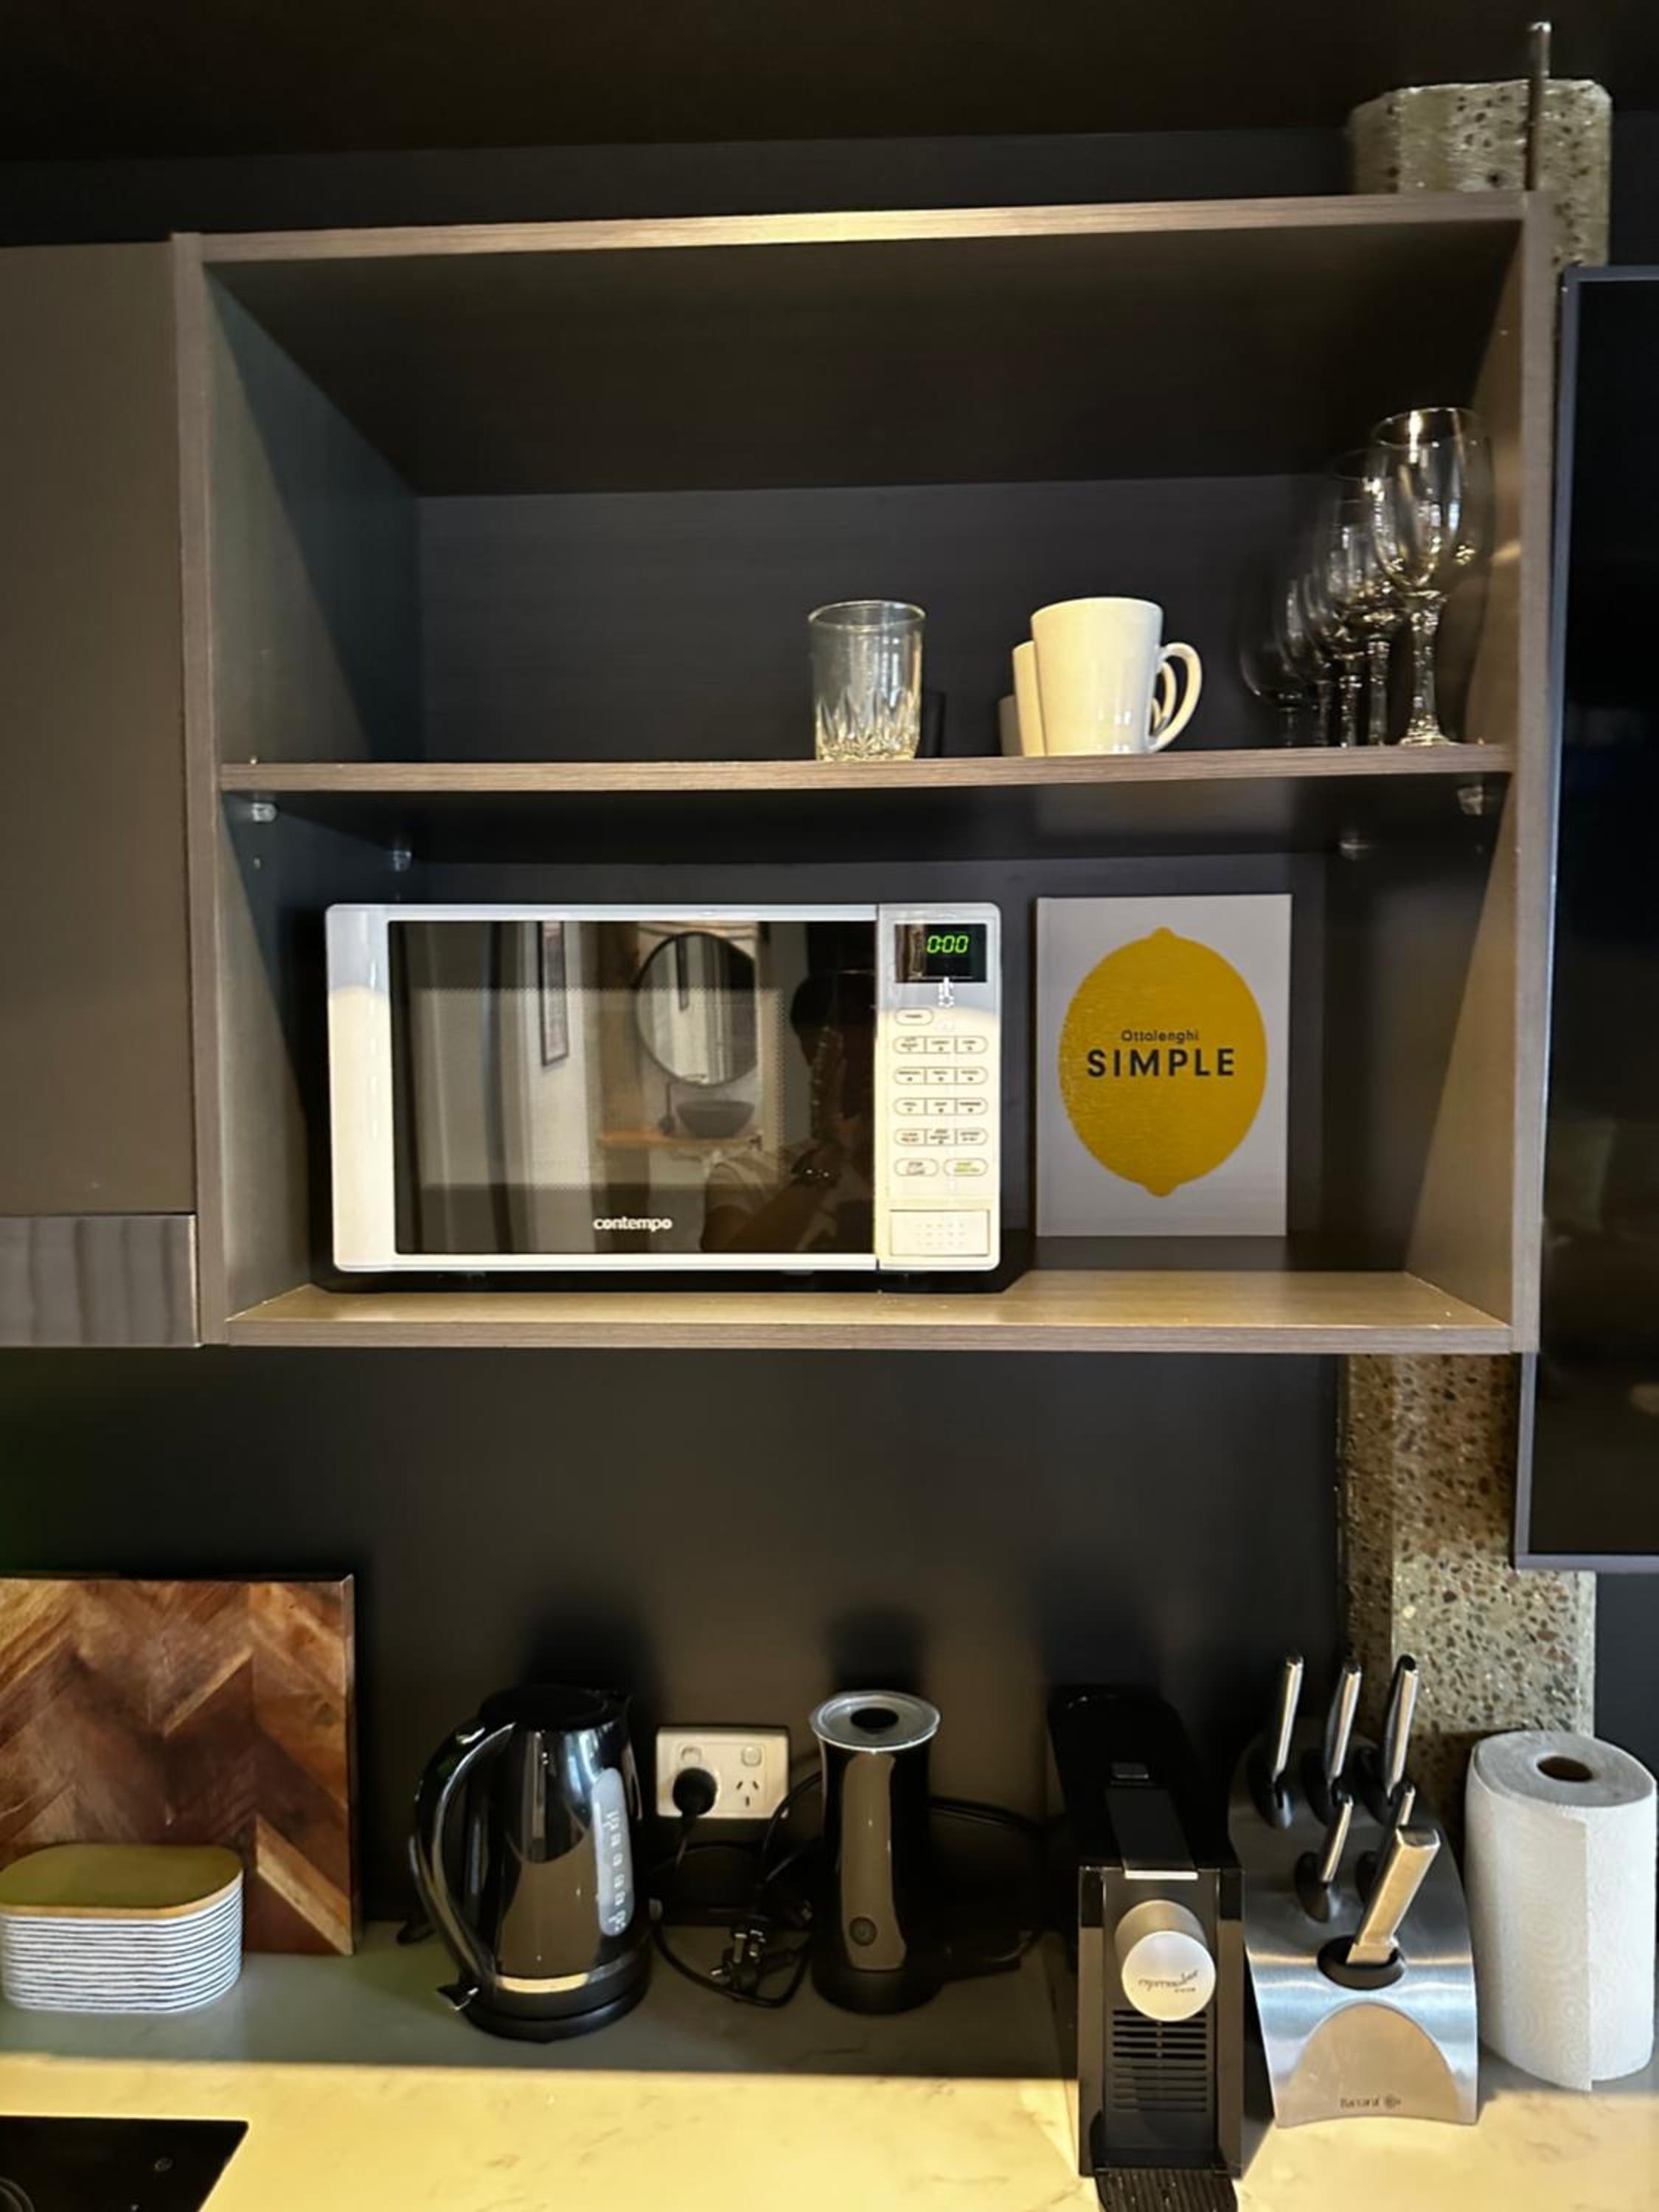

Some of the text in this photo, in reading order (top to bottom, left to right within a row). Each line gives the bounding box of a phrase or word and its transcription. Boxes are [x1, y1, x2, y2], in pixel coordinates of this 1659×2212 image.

[927, 935, 969, 953] 0:00
[1121, 1029, 1199, 1044] Ottolenghi
[1087, 1048, 1234, 1077] SIMPLE
[593, 1216, 672, 1232] contempo
